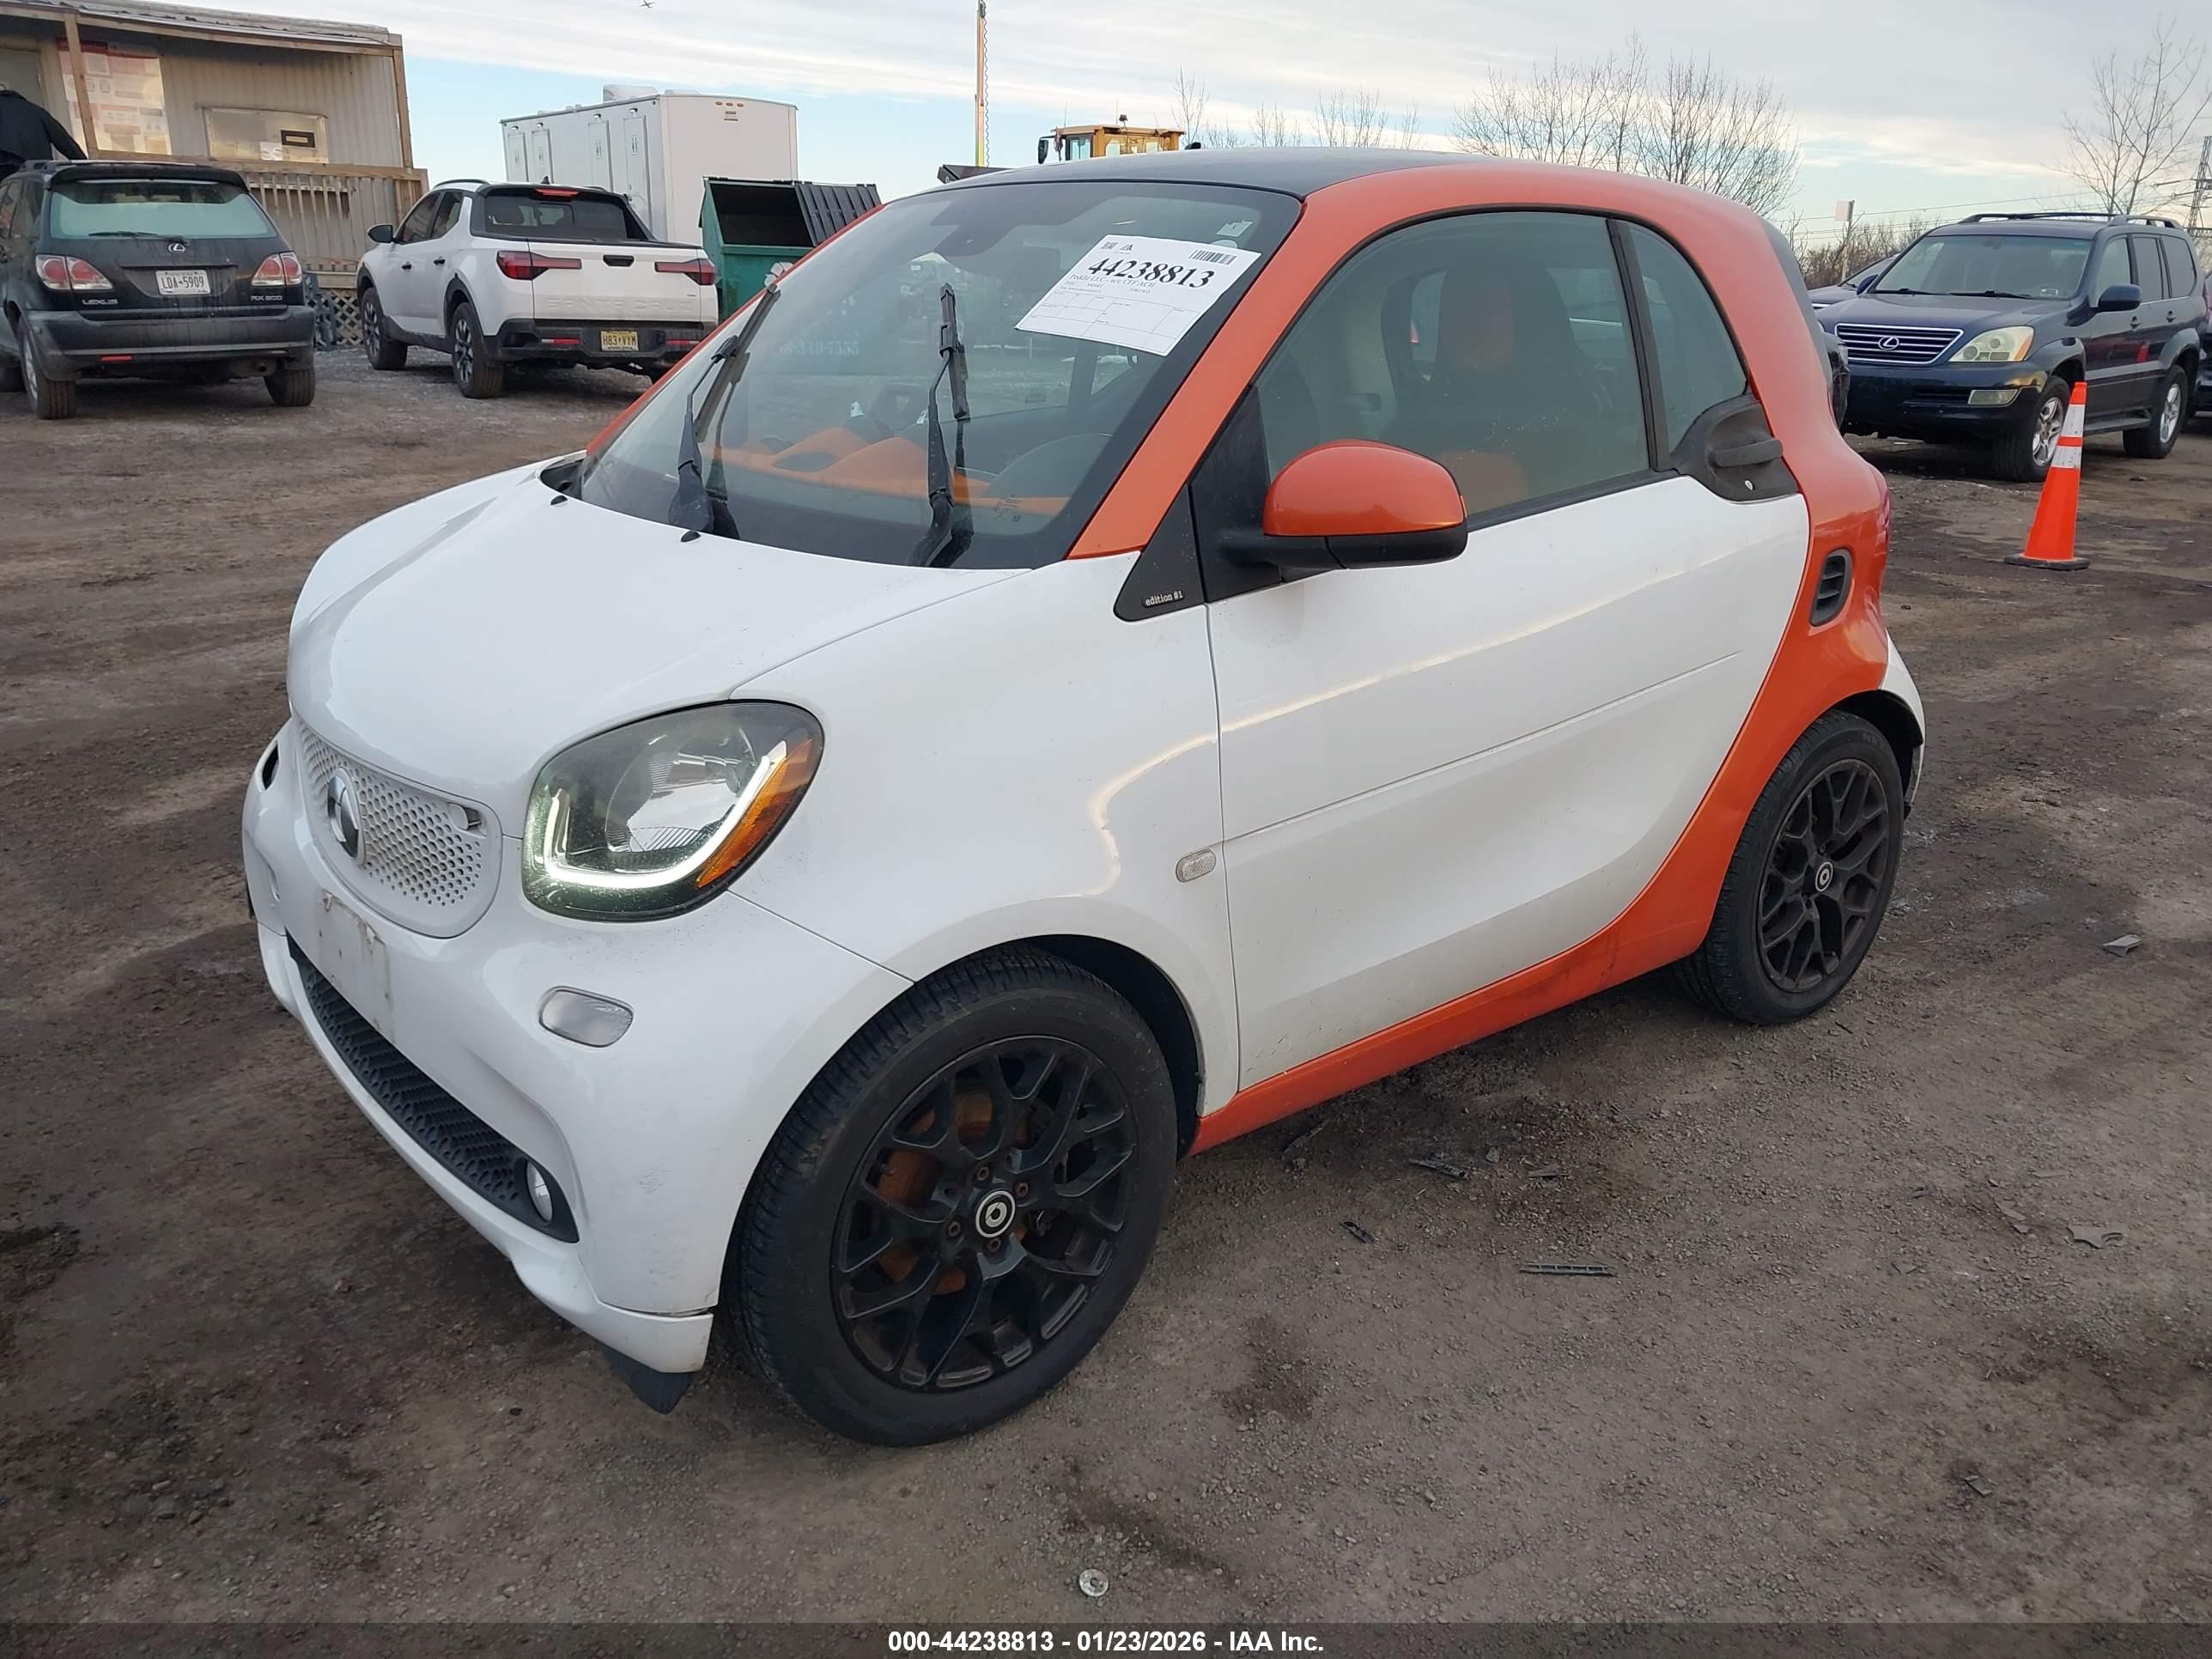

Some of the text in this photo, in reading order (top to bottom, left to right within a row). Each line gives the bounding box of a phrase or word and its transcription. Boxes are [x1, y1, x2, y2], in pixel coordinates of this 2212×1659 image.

[1088, 257, 1215, 289] 44238813
[161, 276, 205, 289] LDA 5909
[544, 296, 626, 311] SANTA
[1146, 591, 1183, 605] edition #1
